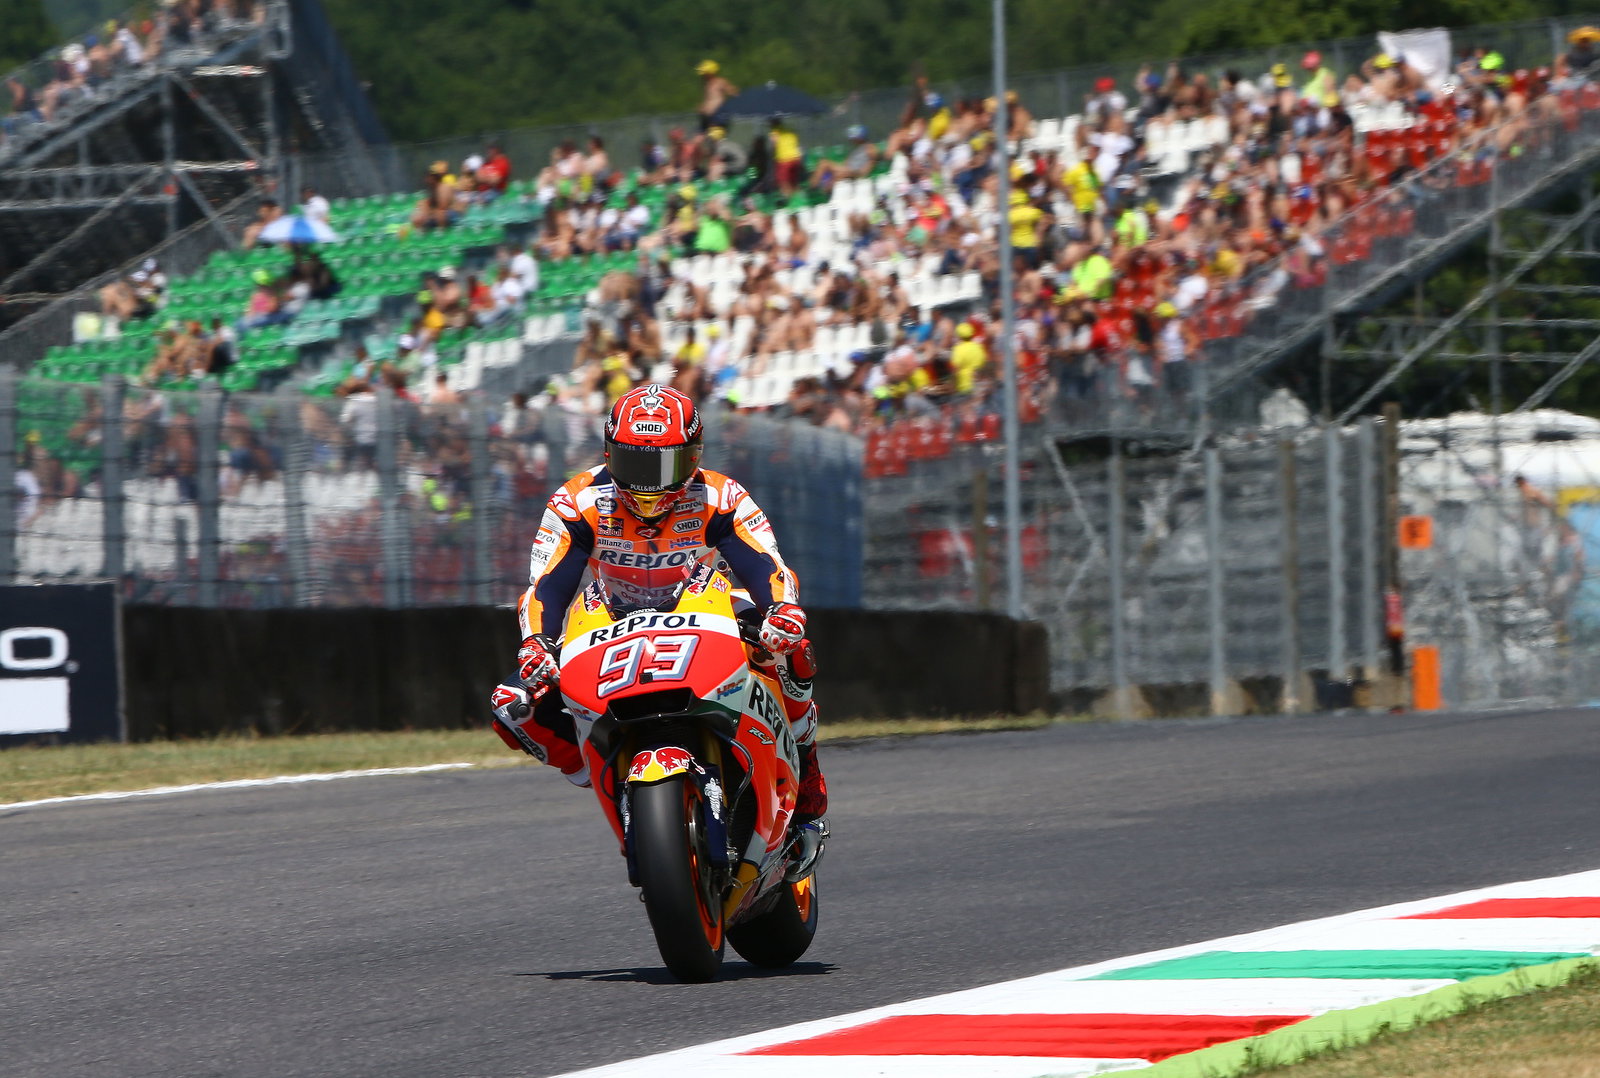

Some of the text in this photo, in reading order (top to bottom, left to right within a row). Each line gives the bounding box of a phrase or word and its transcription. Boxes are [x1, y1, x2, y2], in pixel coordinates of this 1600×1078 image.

[635, 423, 663, 433] SHOEI
[617, 443, 636, 451] GIVES
[630, 483, 665, 492] PULL&BEAR
[675, 501, 702, 512] REPSOL
[677, 520, 700, 532] SHOEI
[596, 538, 622, 548] Allianz
[626, 607, 658, 618] HONDA
[589, 614, 701, 647] REPSOL
[597, 634, 700, 698] 93
